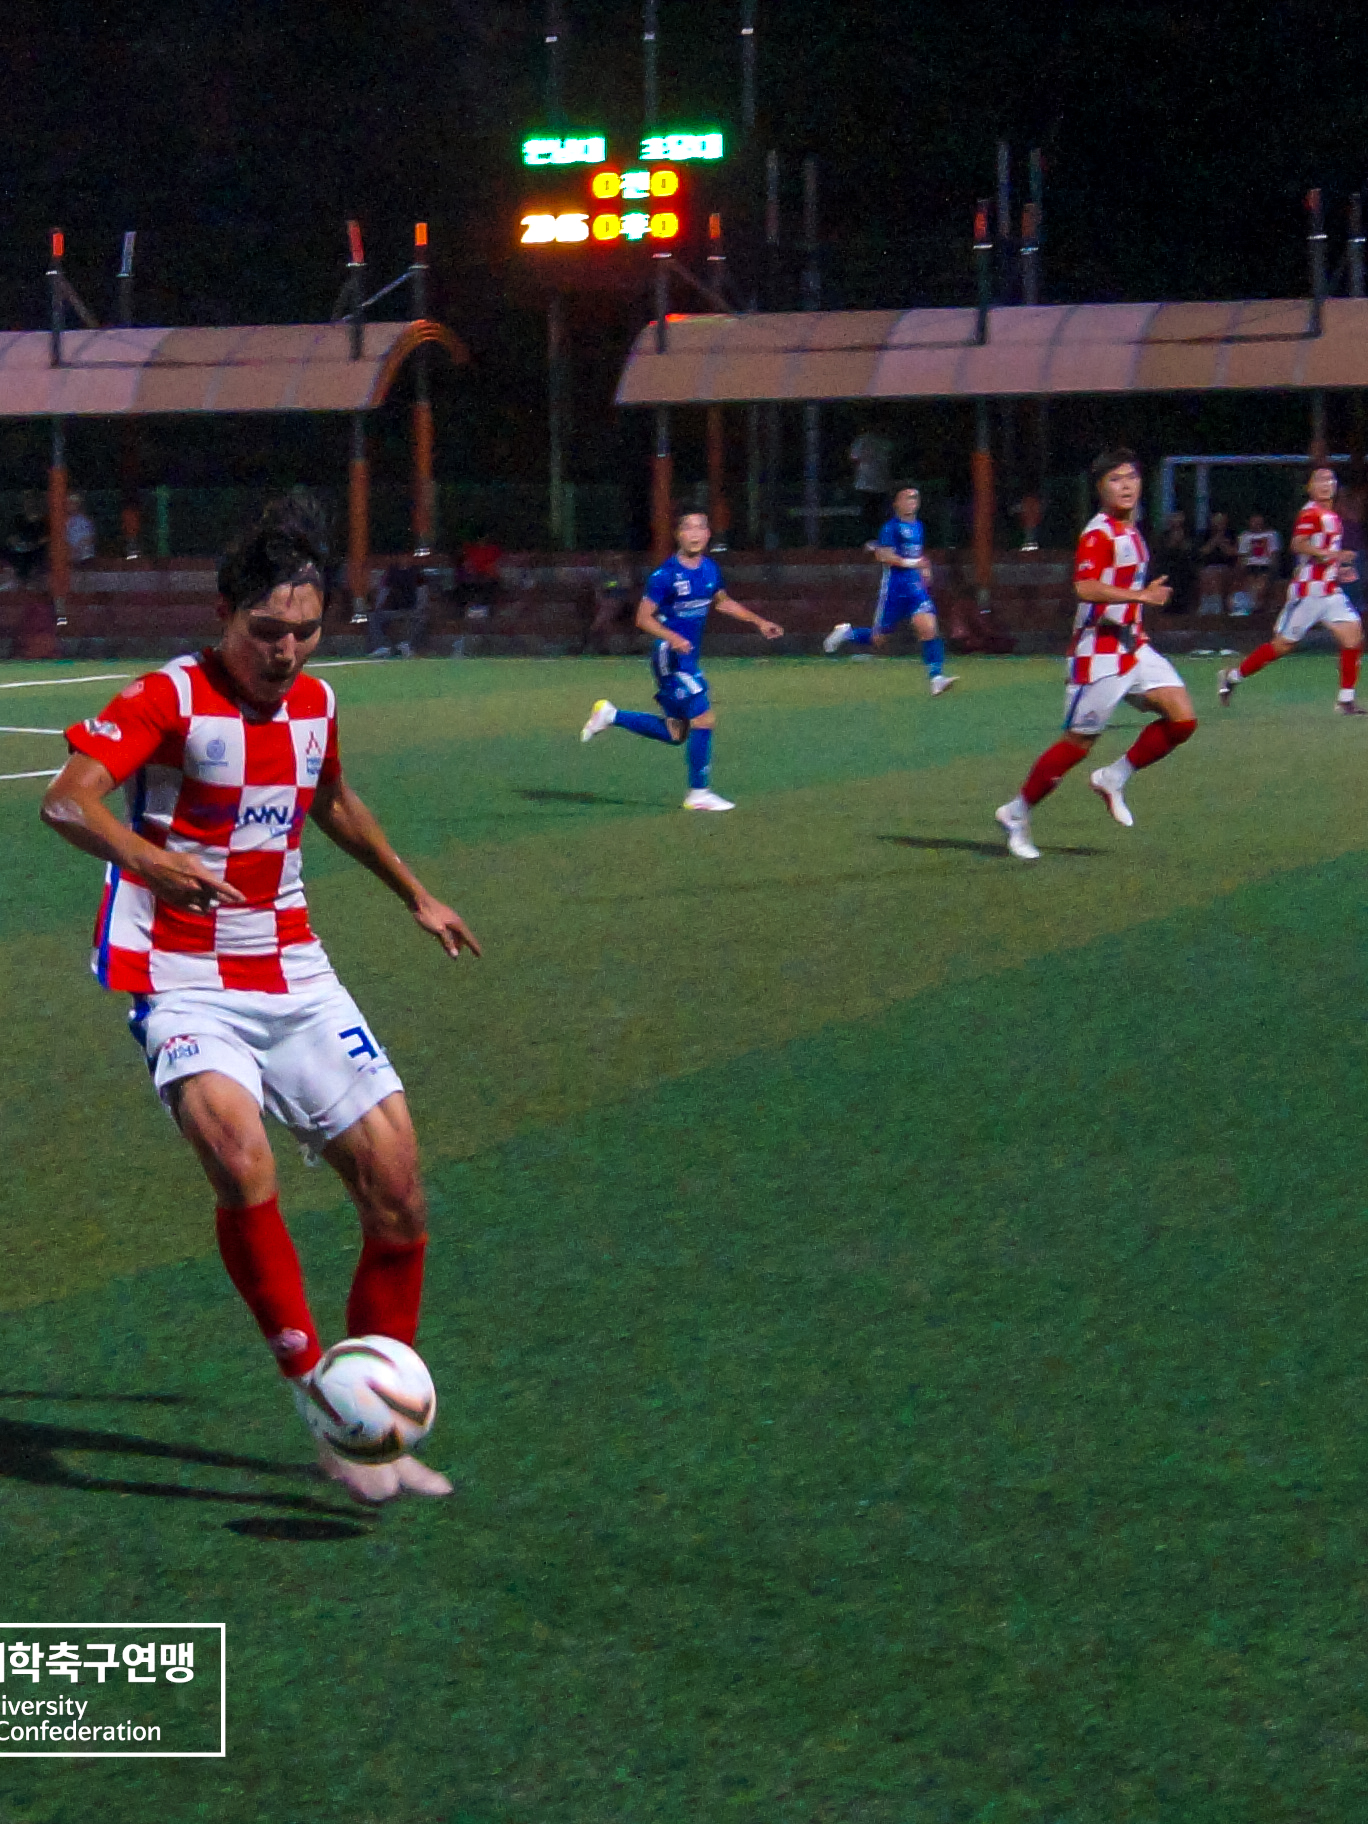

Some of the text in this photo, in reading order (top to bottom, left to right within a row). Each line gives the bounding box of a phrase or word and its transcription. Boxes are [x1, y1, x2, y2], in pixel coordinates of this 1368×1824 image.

[592, 172, 620, 199] 0
[650, 170, 678, 197] 0
[592, 213, 620, 240] 0
[650, 212, 678, 239] 0
